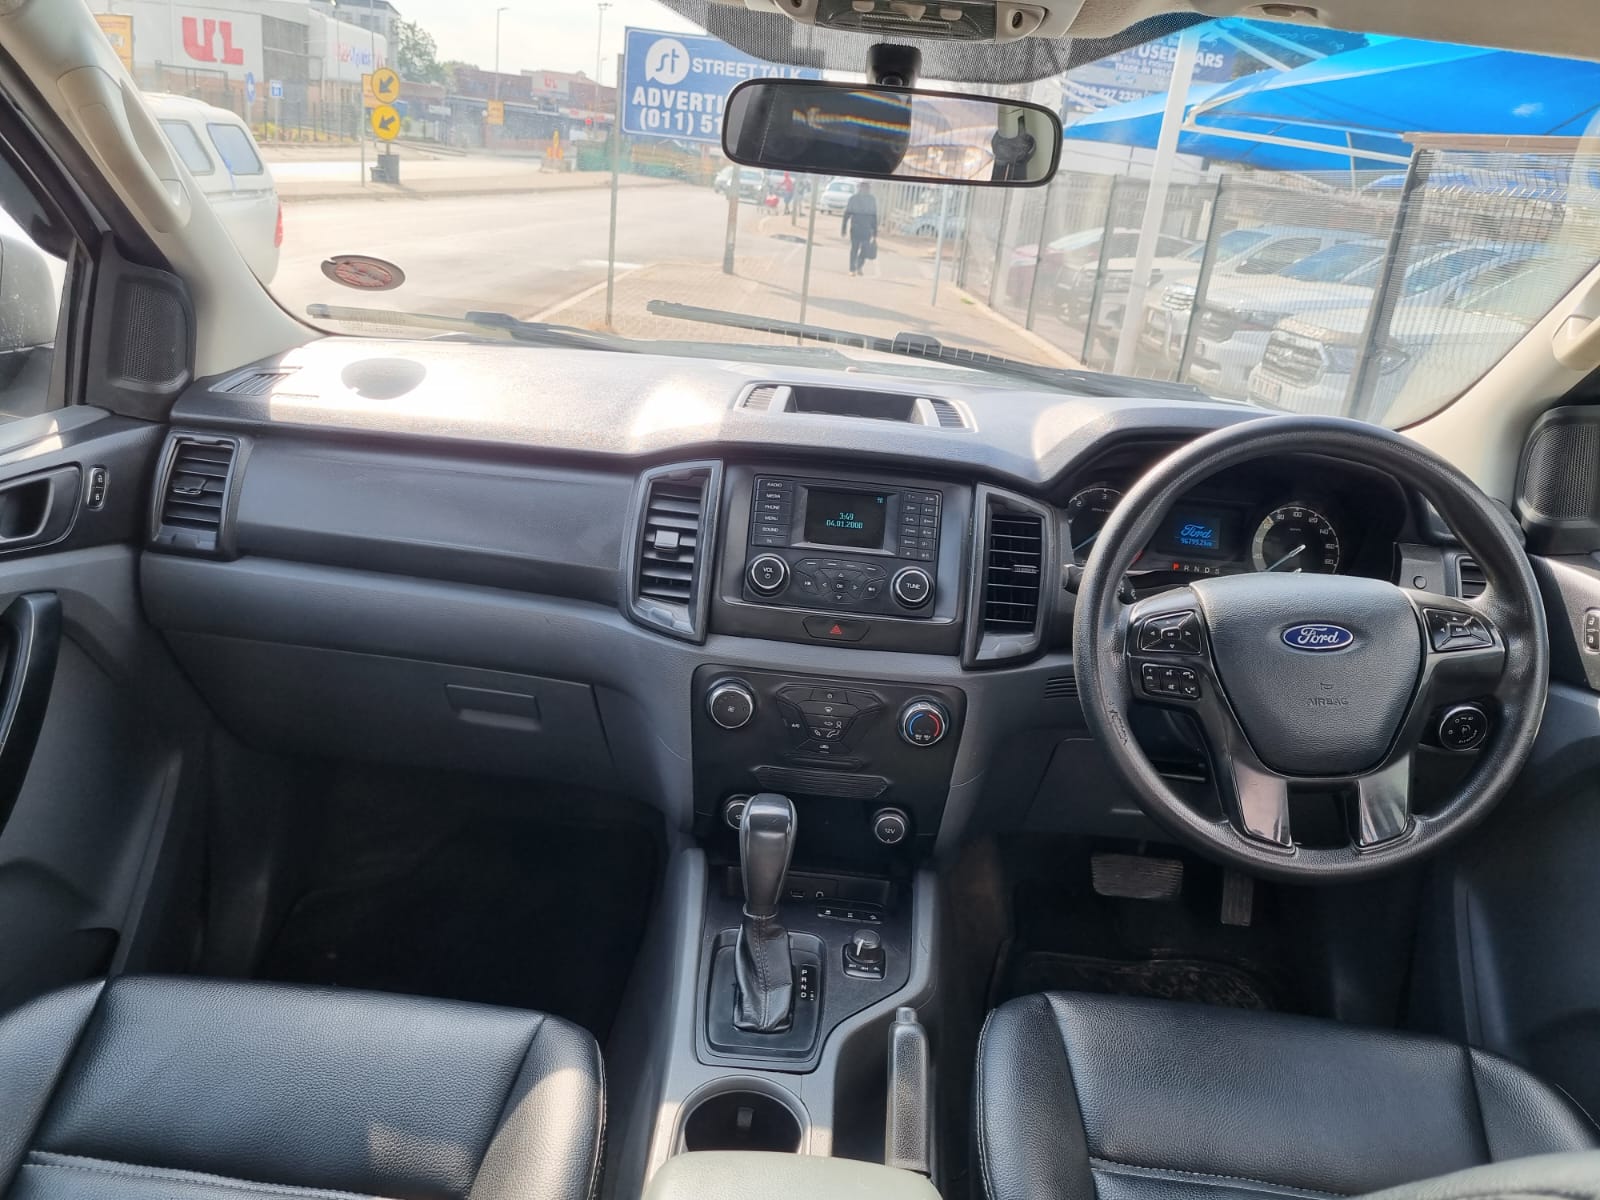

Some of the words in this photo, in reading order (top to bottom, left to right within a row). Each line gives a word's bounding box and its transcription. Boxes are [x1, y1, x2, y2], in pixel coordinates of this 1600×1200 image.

[182, 16, 244, 65] UL
[1137, 44, 1177, 60] USED
[1195, 52, 1224, 68] ARS
[692, 57, 758, 78] STREET
[632, 86, 726, 113] ADVERTI
[640, 107, 693, 135] (011)
[700, 114, 723, 135] 51
[839, 512, 854, 520] 3:49
[1180, 524, 1213, 539] Ford
[1173, 563, 1179, 571] P
[1184, 564, 1190, 572] R
[1193, 565, 1200, 573] N
[1204, 566, 1210, 574] D
[906, 582, 921, 590] TUNE
[1298, 627, 1340, 645] Ford
[1308, 697, 1349, 707] AIRBAG
